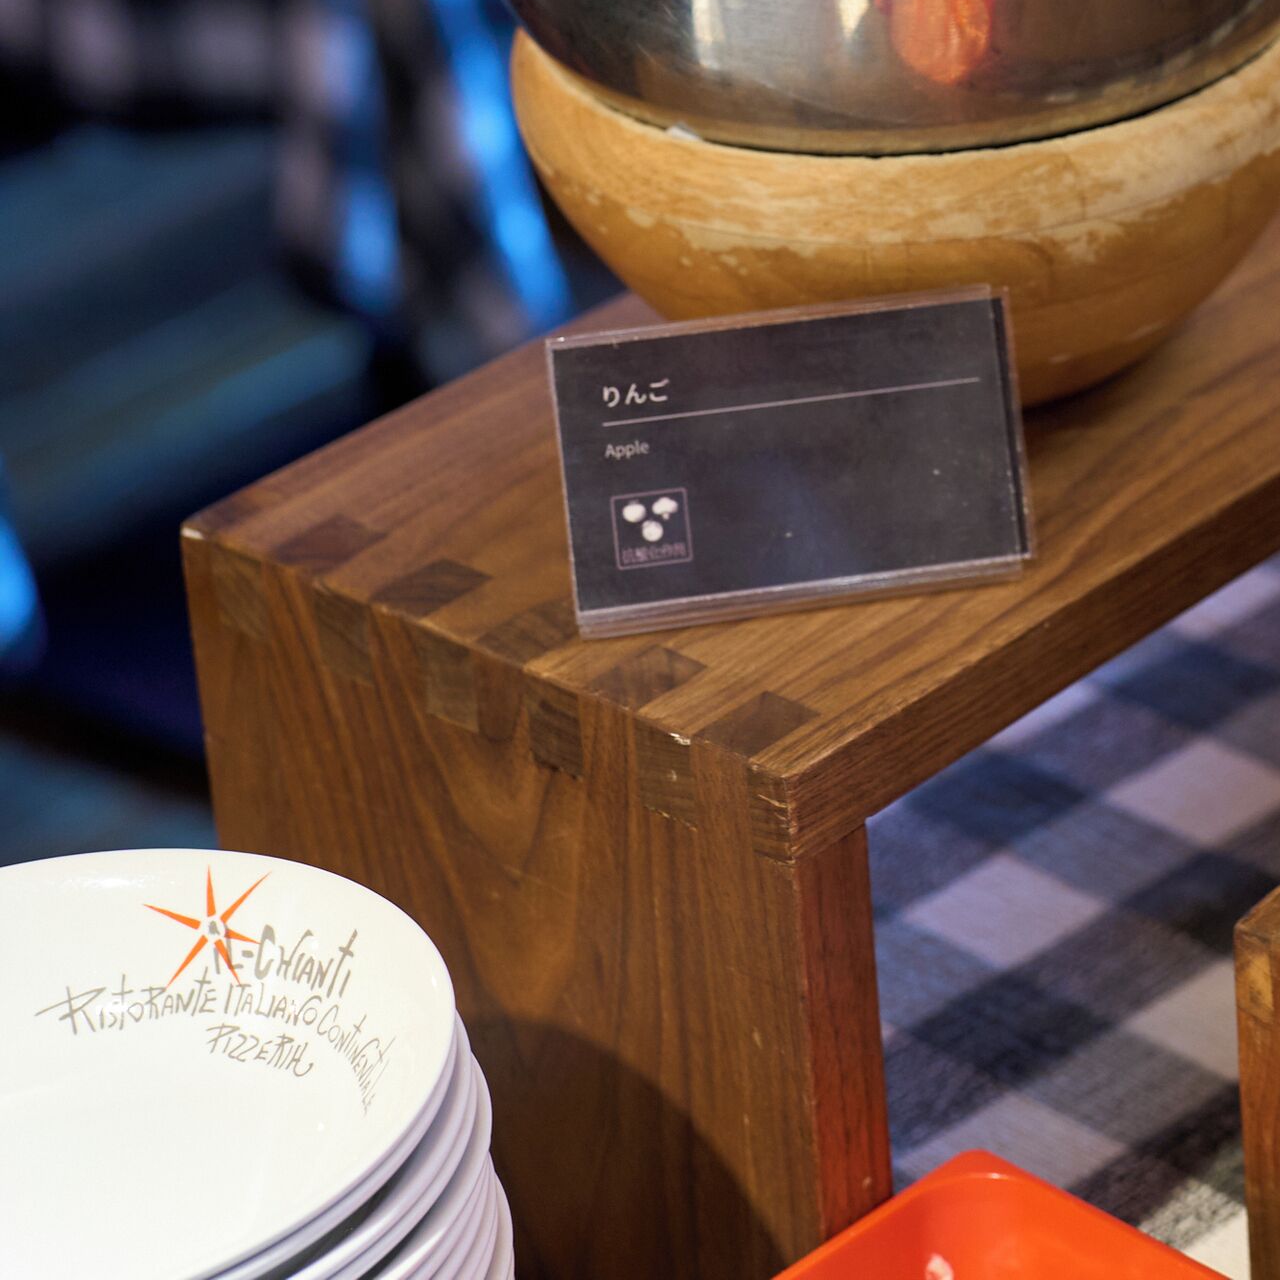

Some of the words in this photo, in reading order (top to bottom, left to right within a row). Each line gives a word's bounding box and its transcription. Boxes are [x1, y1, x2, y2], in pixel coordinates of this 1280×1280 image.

[602, 377, 671, 408] りんご
[604, 440, 650, 460] Apple
